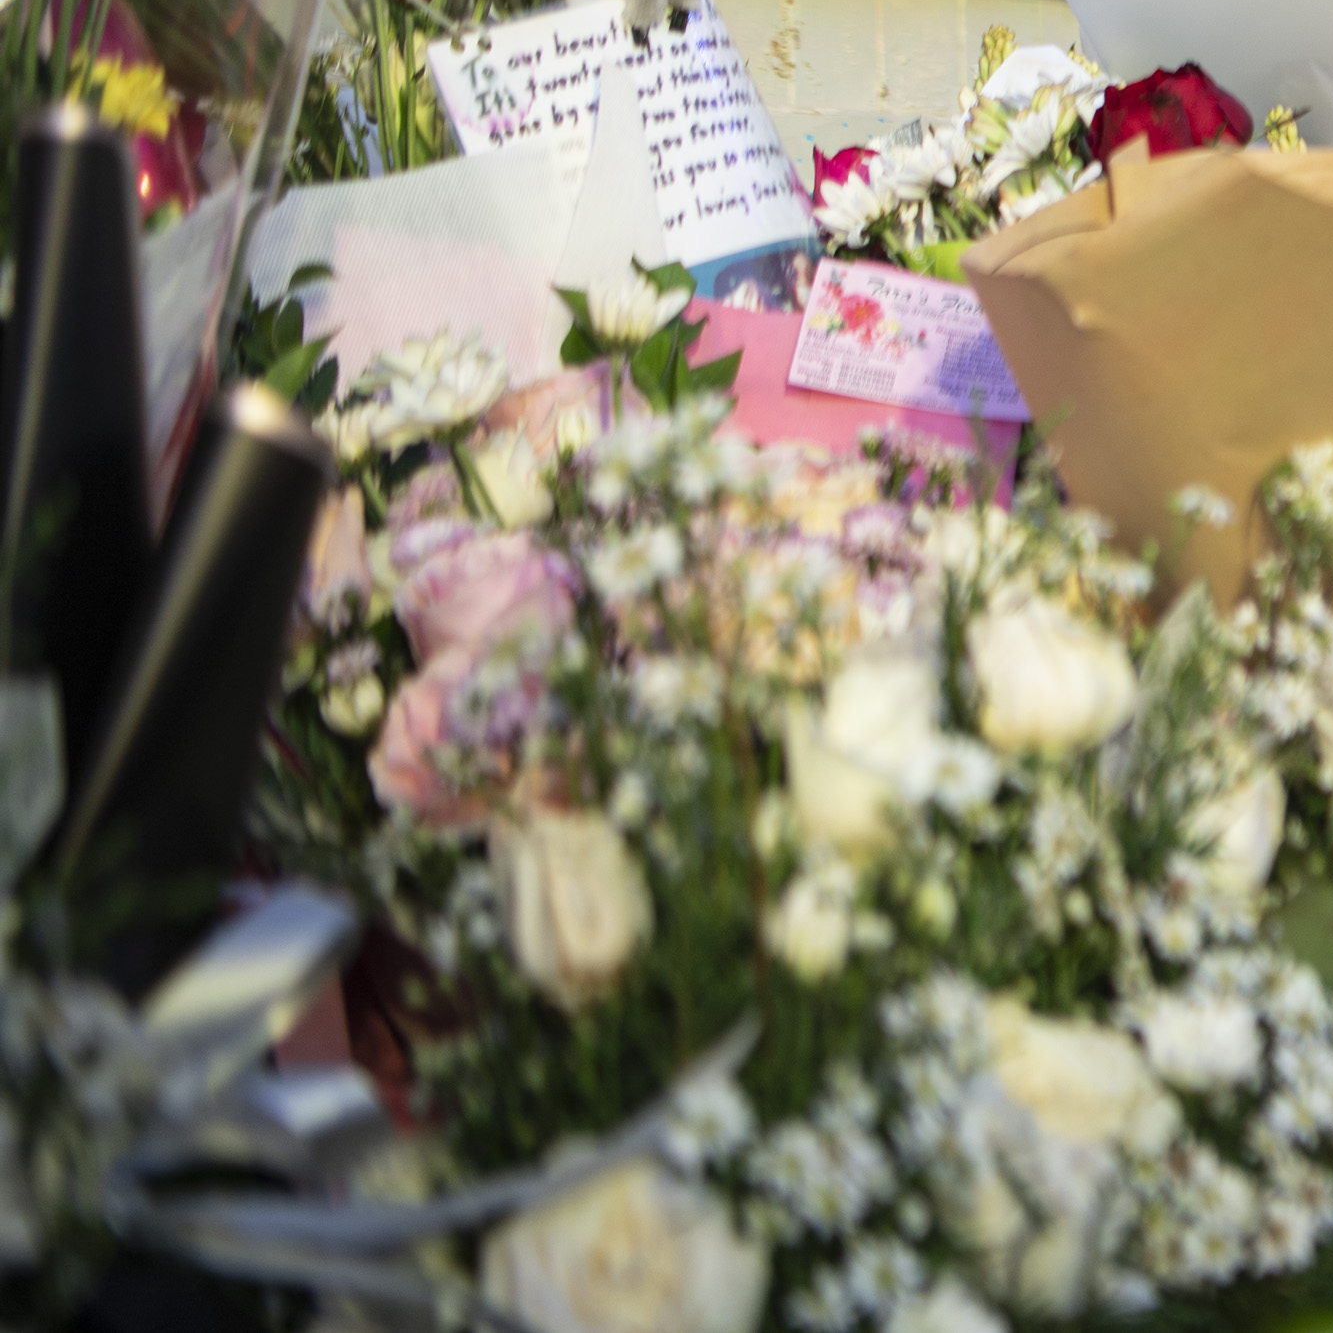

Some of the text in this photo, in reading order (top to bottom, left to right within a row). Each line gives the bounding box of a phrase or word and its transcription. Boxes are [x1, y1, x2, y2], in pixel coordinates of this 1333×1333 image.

[508, 47, 543, 71] our
[553, 17, 630, 57] beauti
[551, 103, 578, 129] by
[685, 159, 717, 188] you
